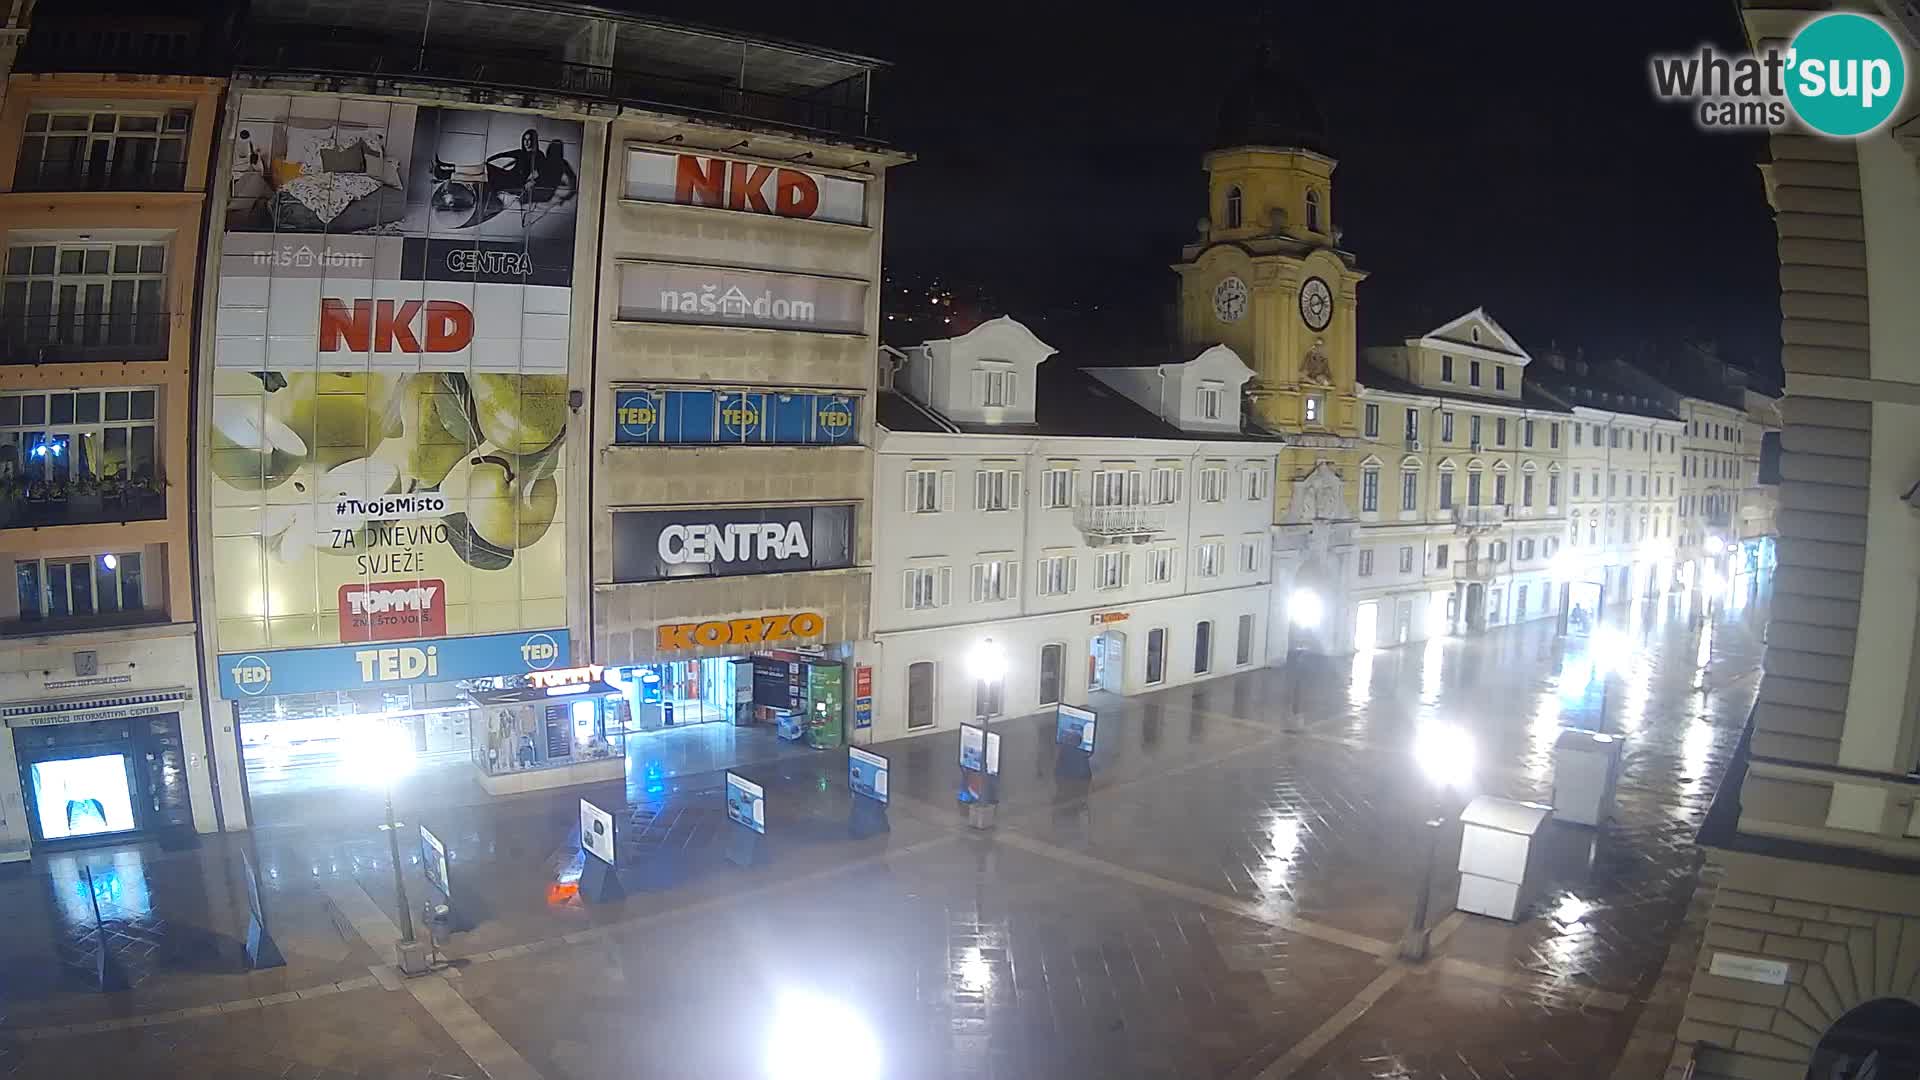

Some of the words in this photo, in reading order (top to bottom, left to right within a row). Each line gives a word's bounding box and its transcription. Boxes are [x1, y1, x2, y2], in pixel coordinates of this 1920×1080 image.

[675, 154, 819, 219] NKD
[253, 247, 289, 267] naš
[318, 246, 364, 268] dom
[446, 249, 533, 275] CENTRA
[660, 284, 717, 316] naš
[752, 289, 816, 323] dom
[319, 298, 474, 353] NKD
[336, 497, 444, 516] #TvojeMisto
[332, 529, 356, 549] ZA
[365, 523, 449, 548] DNEVNO
[657, 521, 809, 564] CENTRA
[357, 547, 425, 576] SVJEŽE
[346, 586, 438, 615] TOMMY
[658, 612, 826, 651] KORZO
[356, 645, 438, 683] TEDi
[521, 643, 559, 661] TEDi
[232, 664, 272, 684] TEDi
